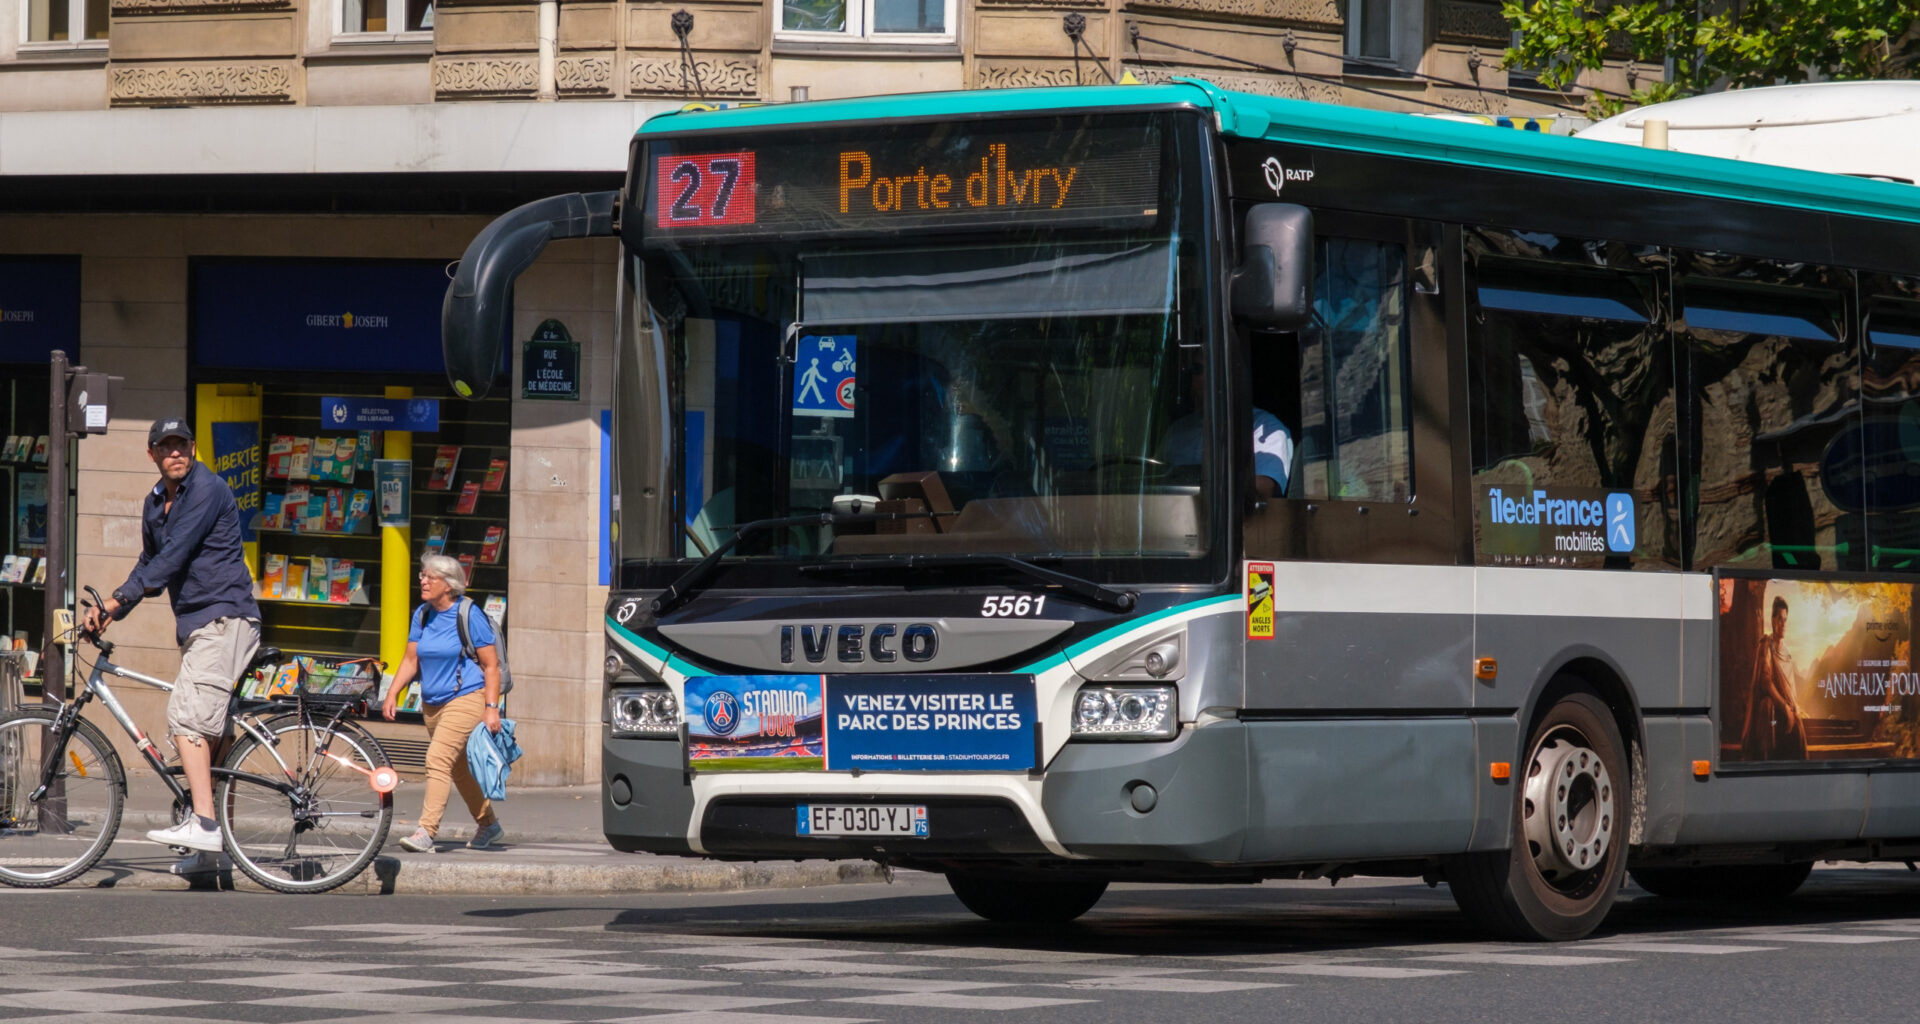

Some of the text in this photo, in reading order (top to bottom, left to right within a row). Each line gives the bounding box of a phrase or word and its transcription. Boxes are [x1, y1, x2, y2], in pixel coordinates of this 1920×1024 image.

[840, 143, 1077, 213] Porte d'Ivry
[1285, 169, 1314, 181] RATP
[670, 158, 741, 221] 27
[3, 310, 34, 322] JOSEPH
[306, 314, 388, 328] GIBERT JOSEPH
[543, 349, 558, 359] RUE
[536, 367, 564, 379] L'ÉCOLE
[528, 379, 572, 391] DE MÉDECINE
[382, 482, 399, 494] BAC
[1555, 530, 1604, 552] mobilités
[981, 594, 1046, 617] 5561
[1252, 616, 1271, 625] ANGLES
[1252, 625, 1270, 633] MORTS
[780, 623, 939, 664] IVECO
[1824, 672, 1885, 699] ANNEAUX
[710, 693, 733, 705] PARIS
[743, 689, 808, 717] STADIUM
[844, 693, 1014, 711] VENEZ VISITER LE
[759, 712, 796, 737] TOUR
[838, 713, 1021, 730] PARC DES PRINCES
[801, 807, 928, 833] F EF-030-YJ 75
